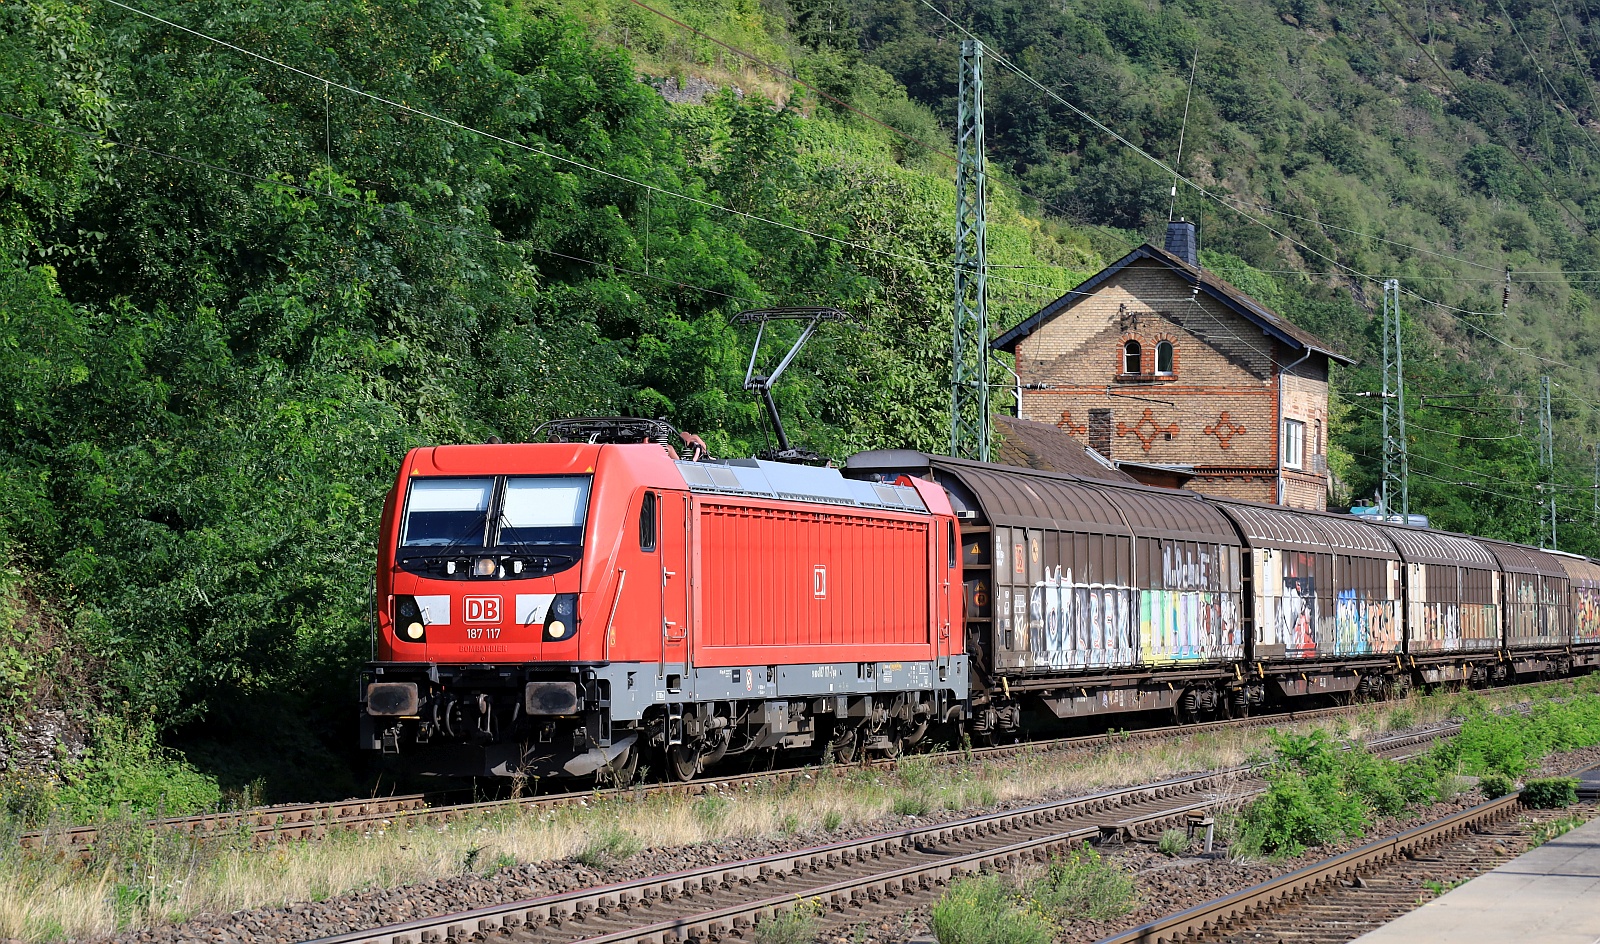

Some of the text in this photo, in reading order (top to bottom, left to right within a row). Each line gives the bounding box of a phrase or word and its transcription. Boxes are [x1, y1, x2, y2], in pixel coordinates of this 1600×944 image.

[469, 600, 497, 619] DB
[467, 629, 500, 639] 187 117
